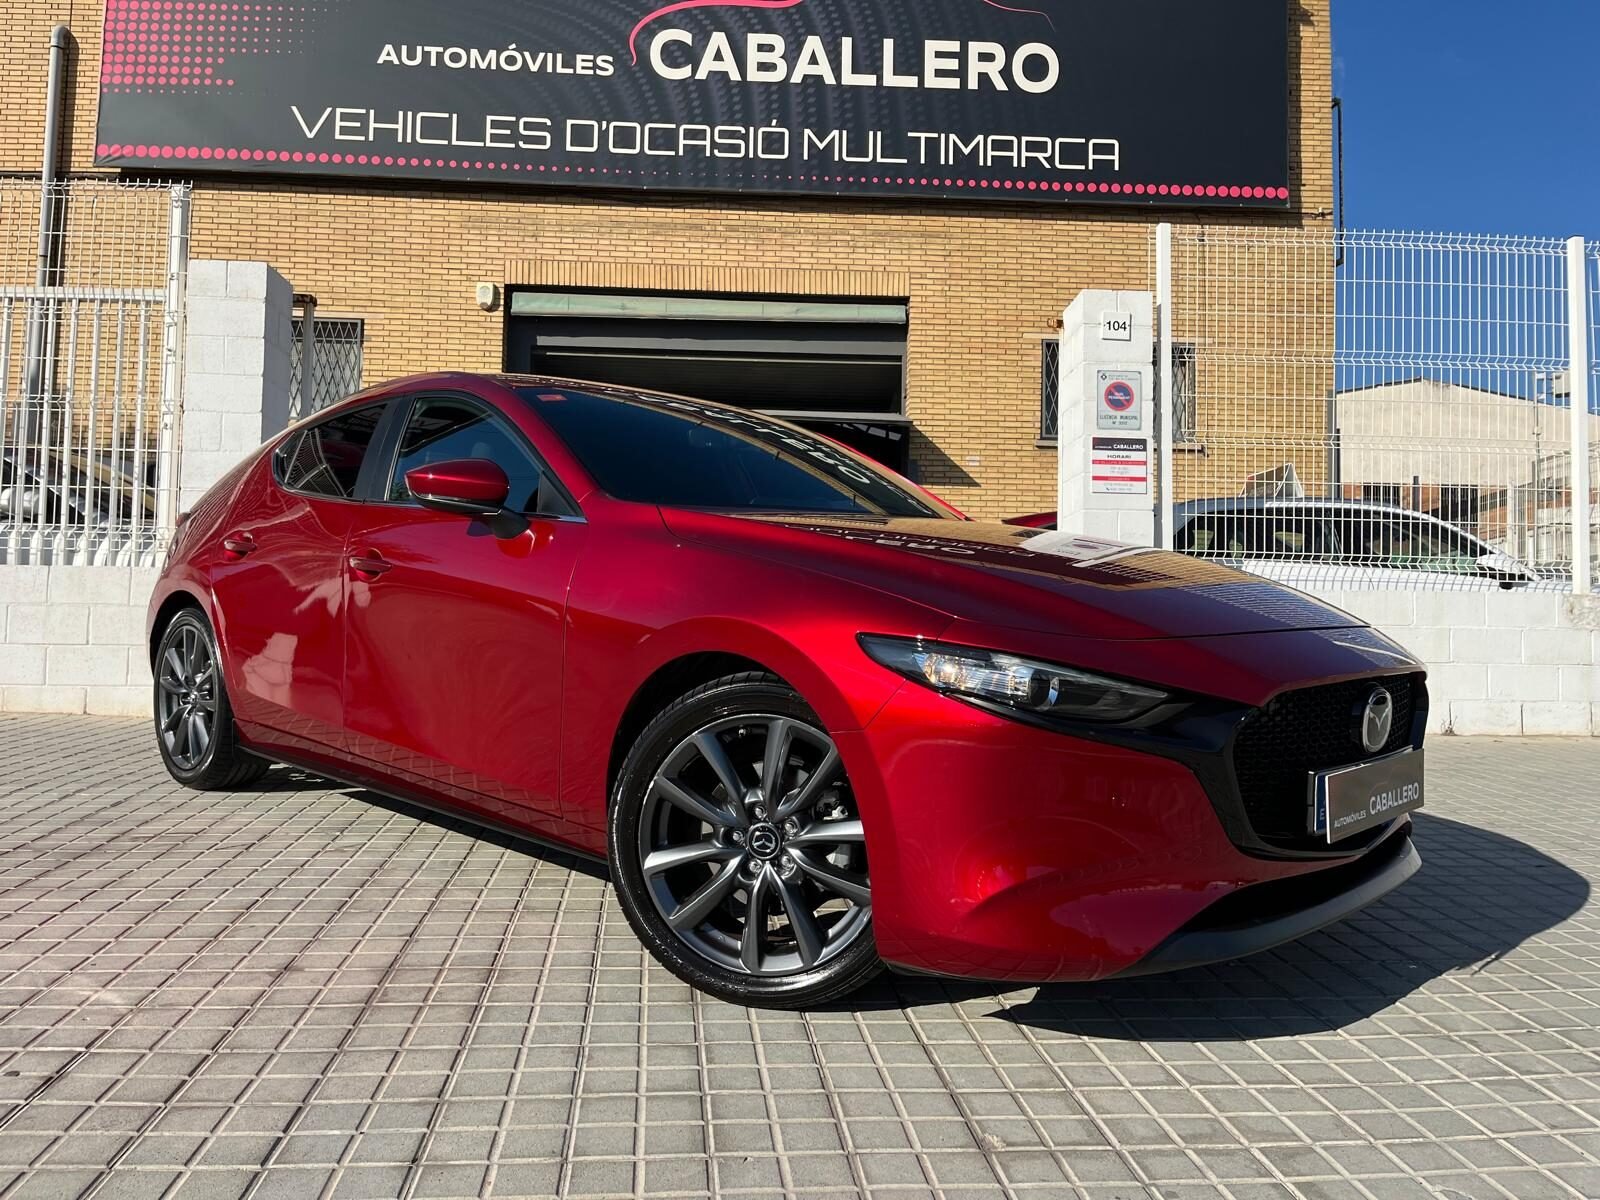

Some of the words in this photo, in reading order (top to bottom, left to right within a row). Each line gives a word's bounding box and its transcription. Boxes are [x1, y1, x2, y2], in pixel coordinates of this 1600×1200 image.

[376, 43, 615, 77] AUTOMÓVILES
[649, 28, 1060, 94] CABALLERO
[290, 105, 552, 150] VEHICLES
[565, 118, 790, 160] D'OCASIÓ
[1106, 320, 1127, 331] 104
[1369, 782, 1420, 815] CABALLERO
